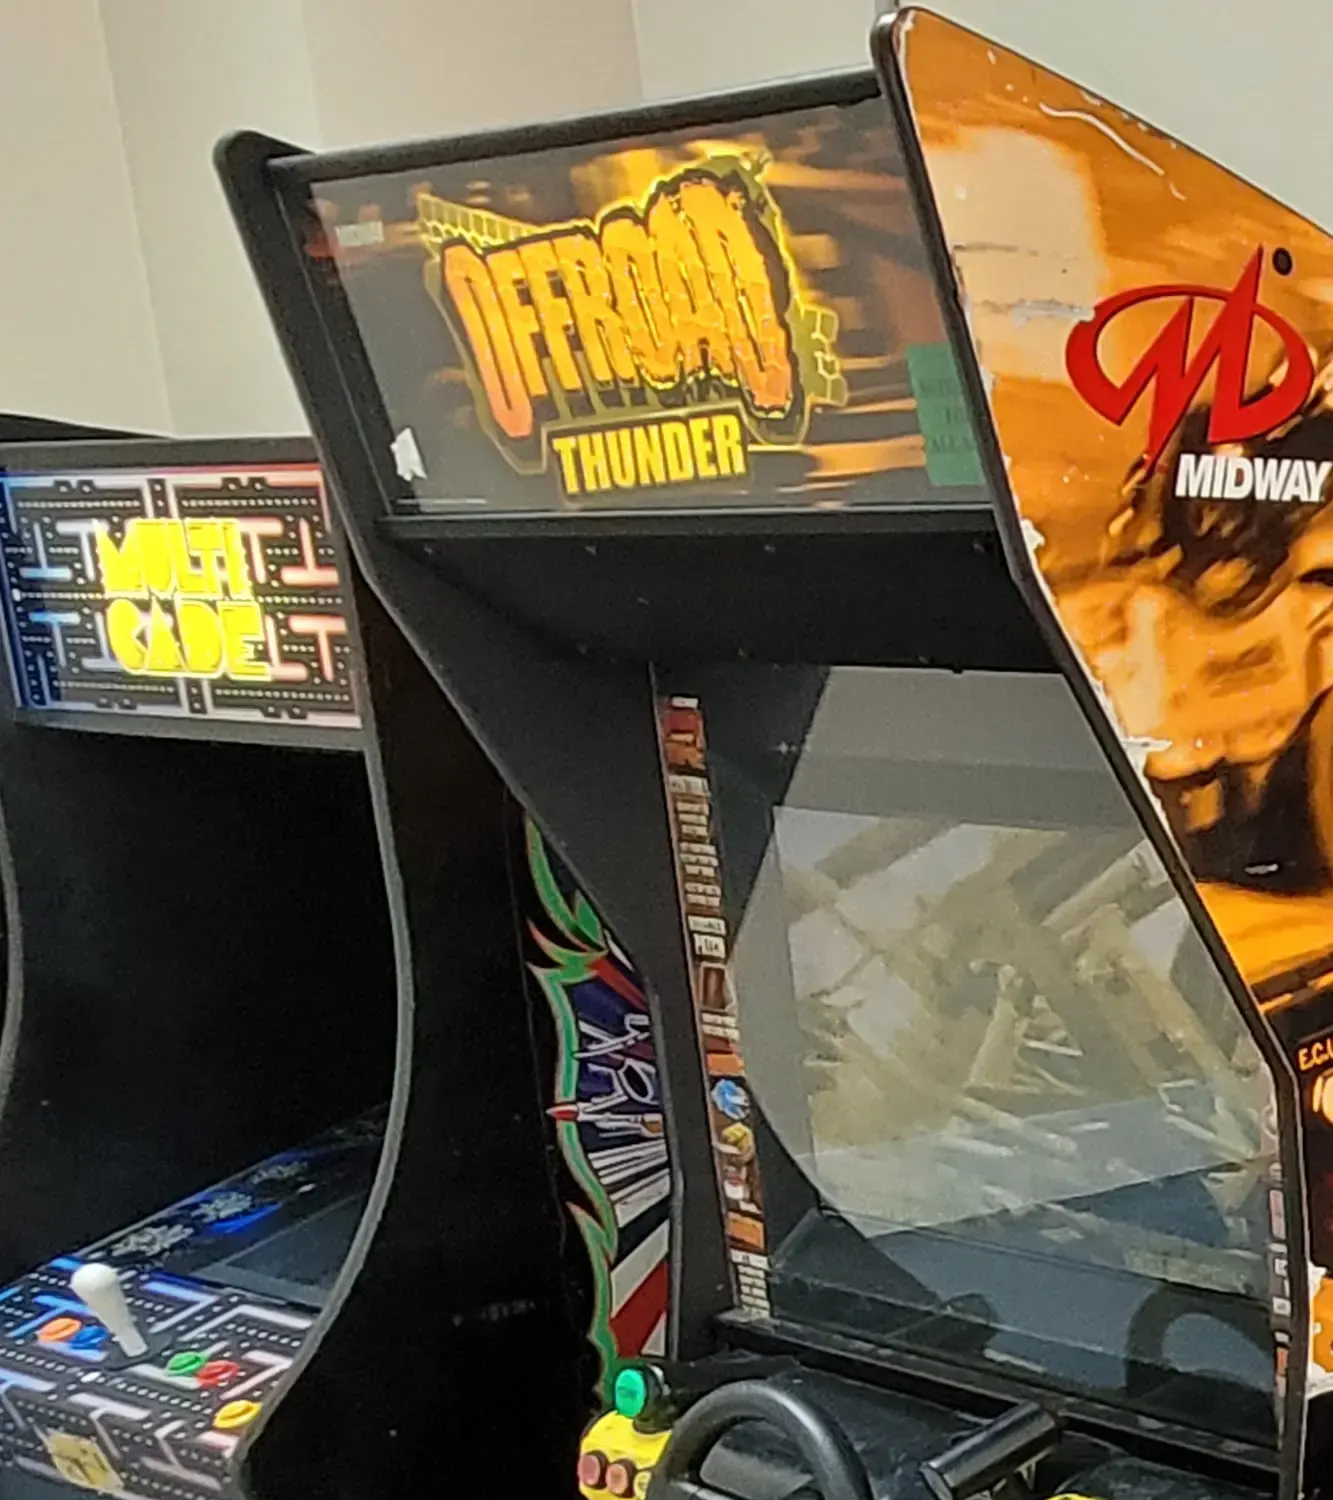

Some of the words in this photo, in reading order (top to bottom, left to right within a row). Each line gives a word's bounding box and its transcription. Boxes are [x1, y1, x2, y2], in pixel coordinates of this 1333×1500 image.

[443, 179, 795, 437] OFFROAD
[551, 413, 749, 494] THUNDER
[1174, 453, 1333, 502] MIDWAY
[106, 598, 272, 681] CADE
